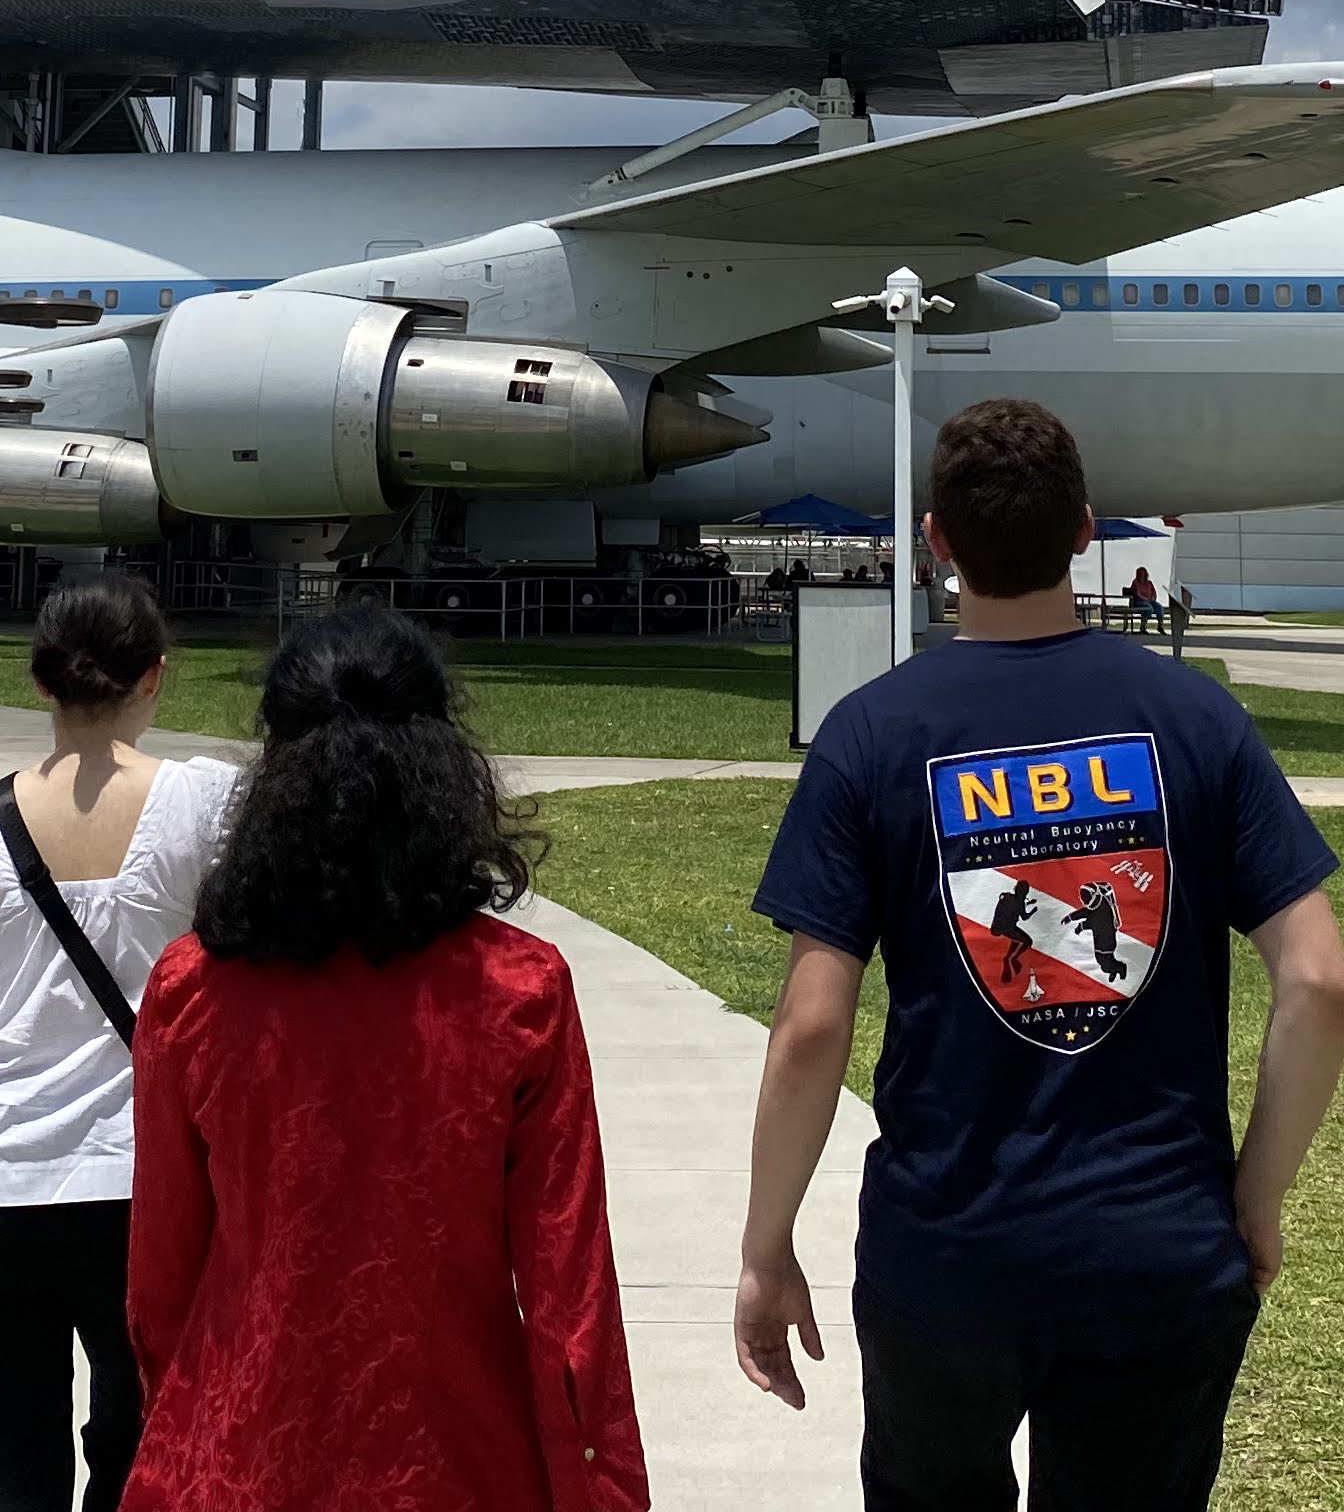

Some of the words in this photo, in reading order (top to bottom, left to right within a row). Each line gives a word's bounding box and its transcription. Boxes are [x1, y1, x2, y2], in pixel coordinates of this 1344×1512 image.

[957, 755, 1133, 822] NBL
[970, 829, 1035, 847] Neutral
[1051, 819, 1136, 838] Buoyancy
[1011, 839, 1098, 858] Laboratory
[1021, 1008, 1065, 1024] NASA
[1087, 1006, 1119, 1017] JSC
